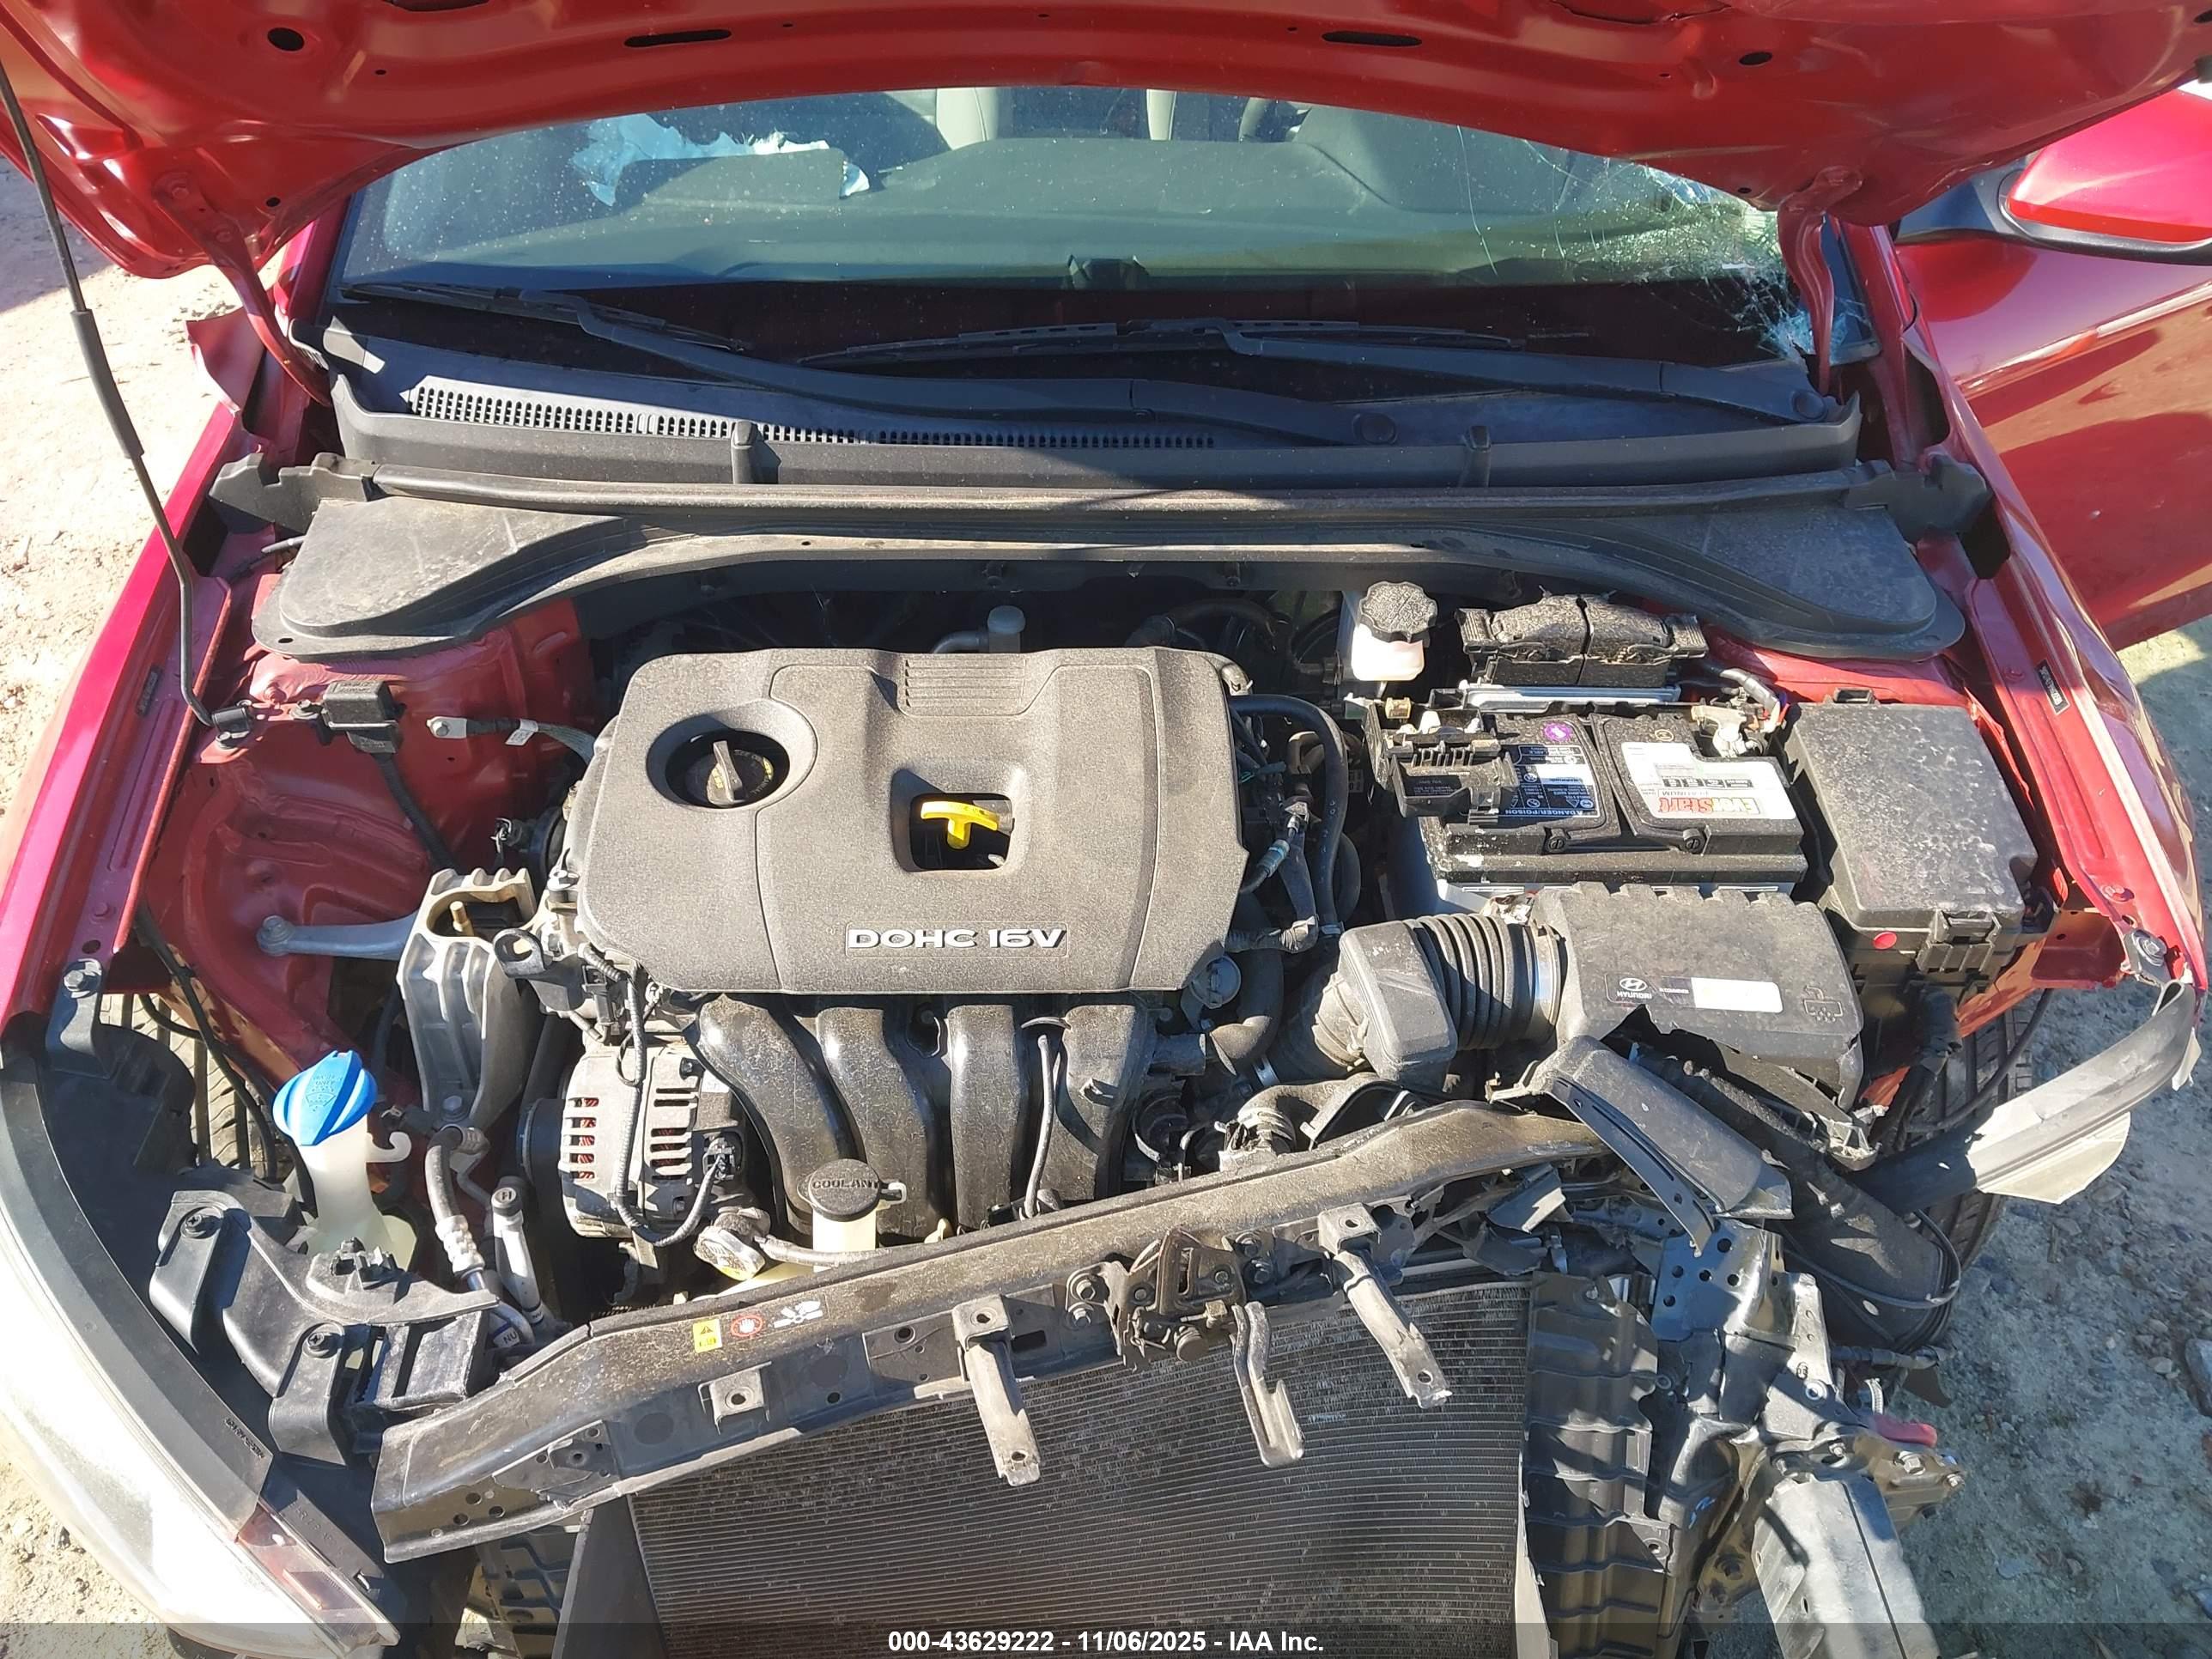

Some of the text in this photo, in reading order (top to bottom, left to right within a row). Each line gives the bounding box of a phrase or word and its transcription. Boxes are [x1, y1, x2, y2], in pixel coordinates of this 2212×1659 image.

[1658, 797, 1760, 814] EverStart
[848, 929, 1066, 949] DOHC 16V
[1616, 990, 1653, 1000] HYUNDAI
[812, 1179, 879, 1189] COOLANT
